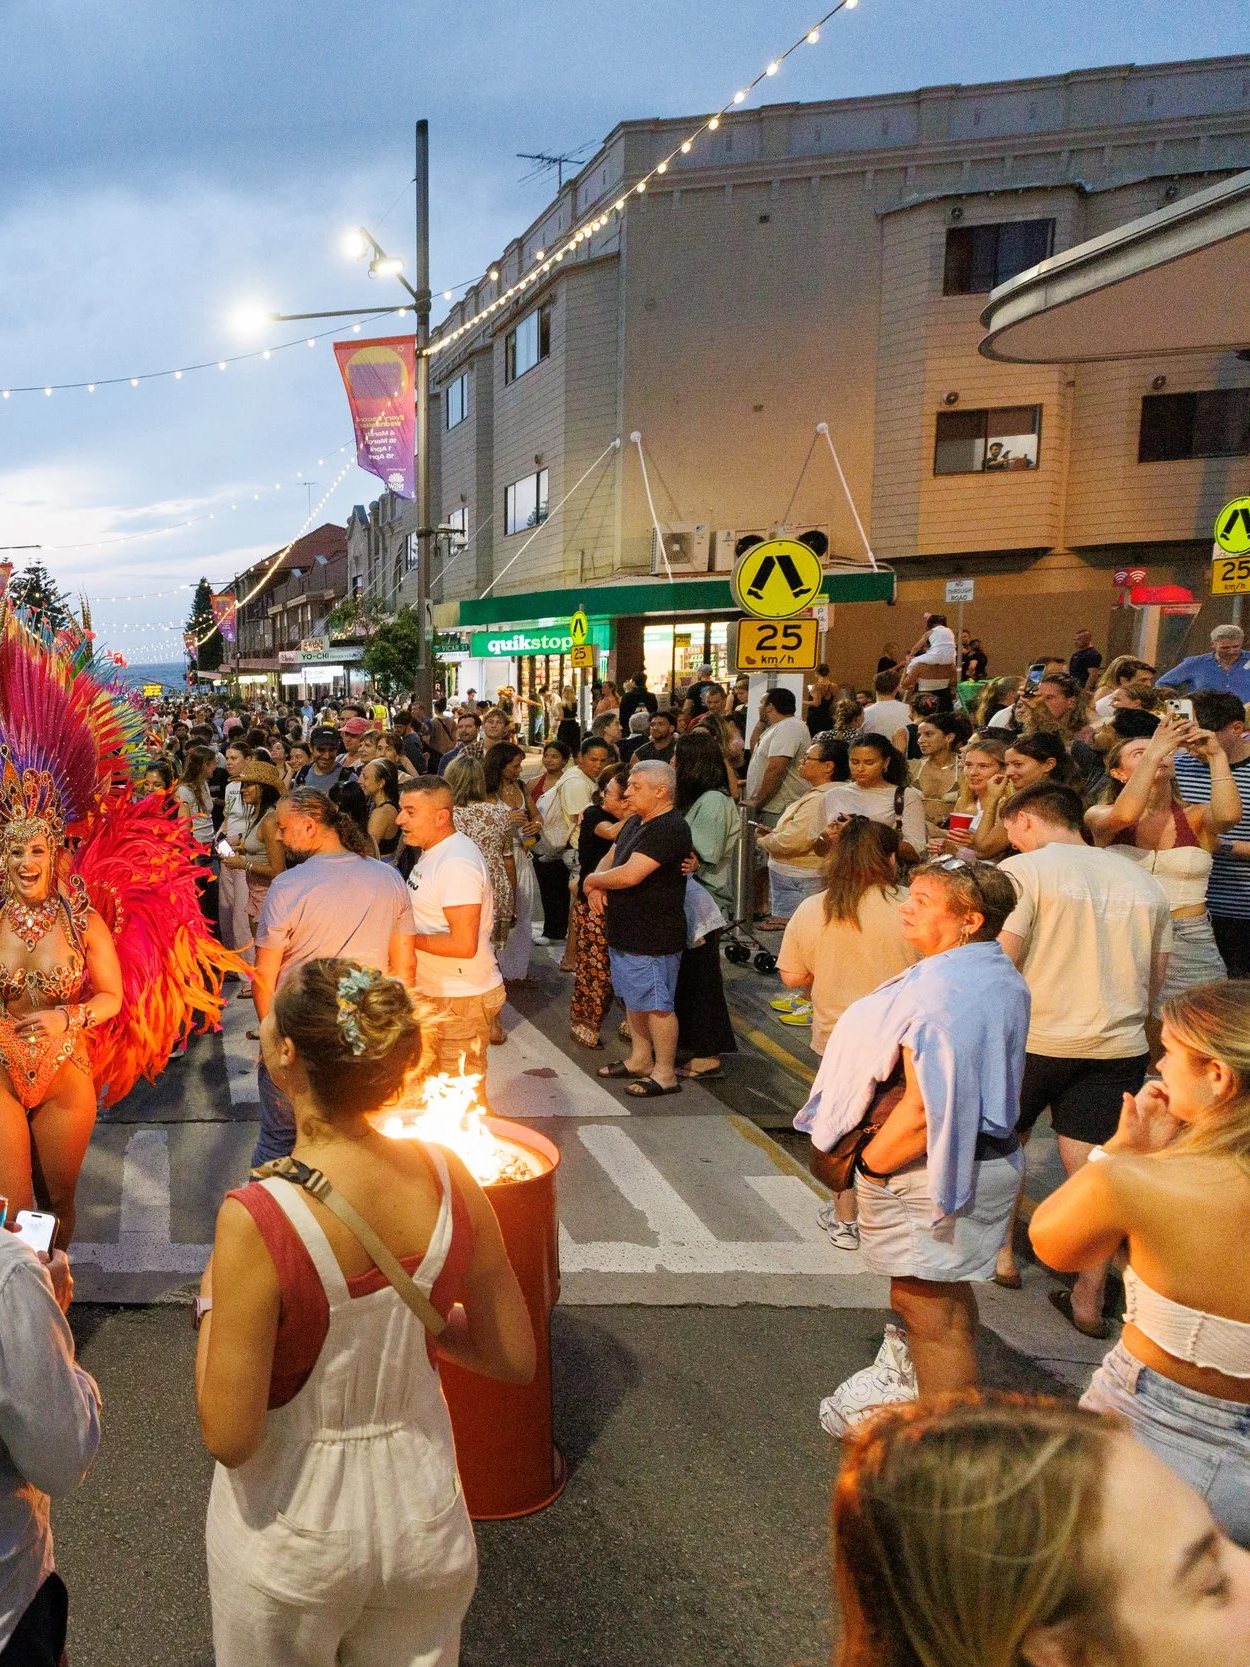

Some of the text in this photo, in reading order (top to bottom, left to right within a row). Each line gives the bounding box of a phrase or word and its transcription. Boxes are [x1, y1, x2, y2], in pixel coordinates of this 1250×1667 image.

[1222, 561, 1250, 581] 25
[755, 624, 803, 651] 25
[441, 644, 459, 652] VICAR
[487, 634, 574, 655] quikstop
[301, 652, 329, 660] YO-CHI
[575, 647, 586, 660] 25
[761, 654, 794, 665] km/h
